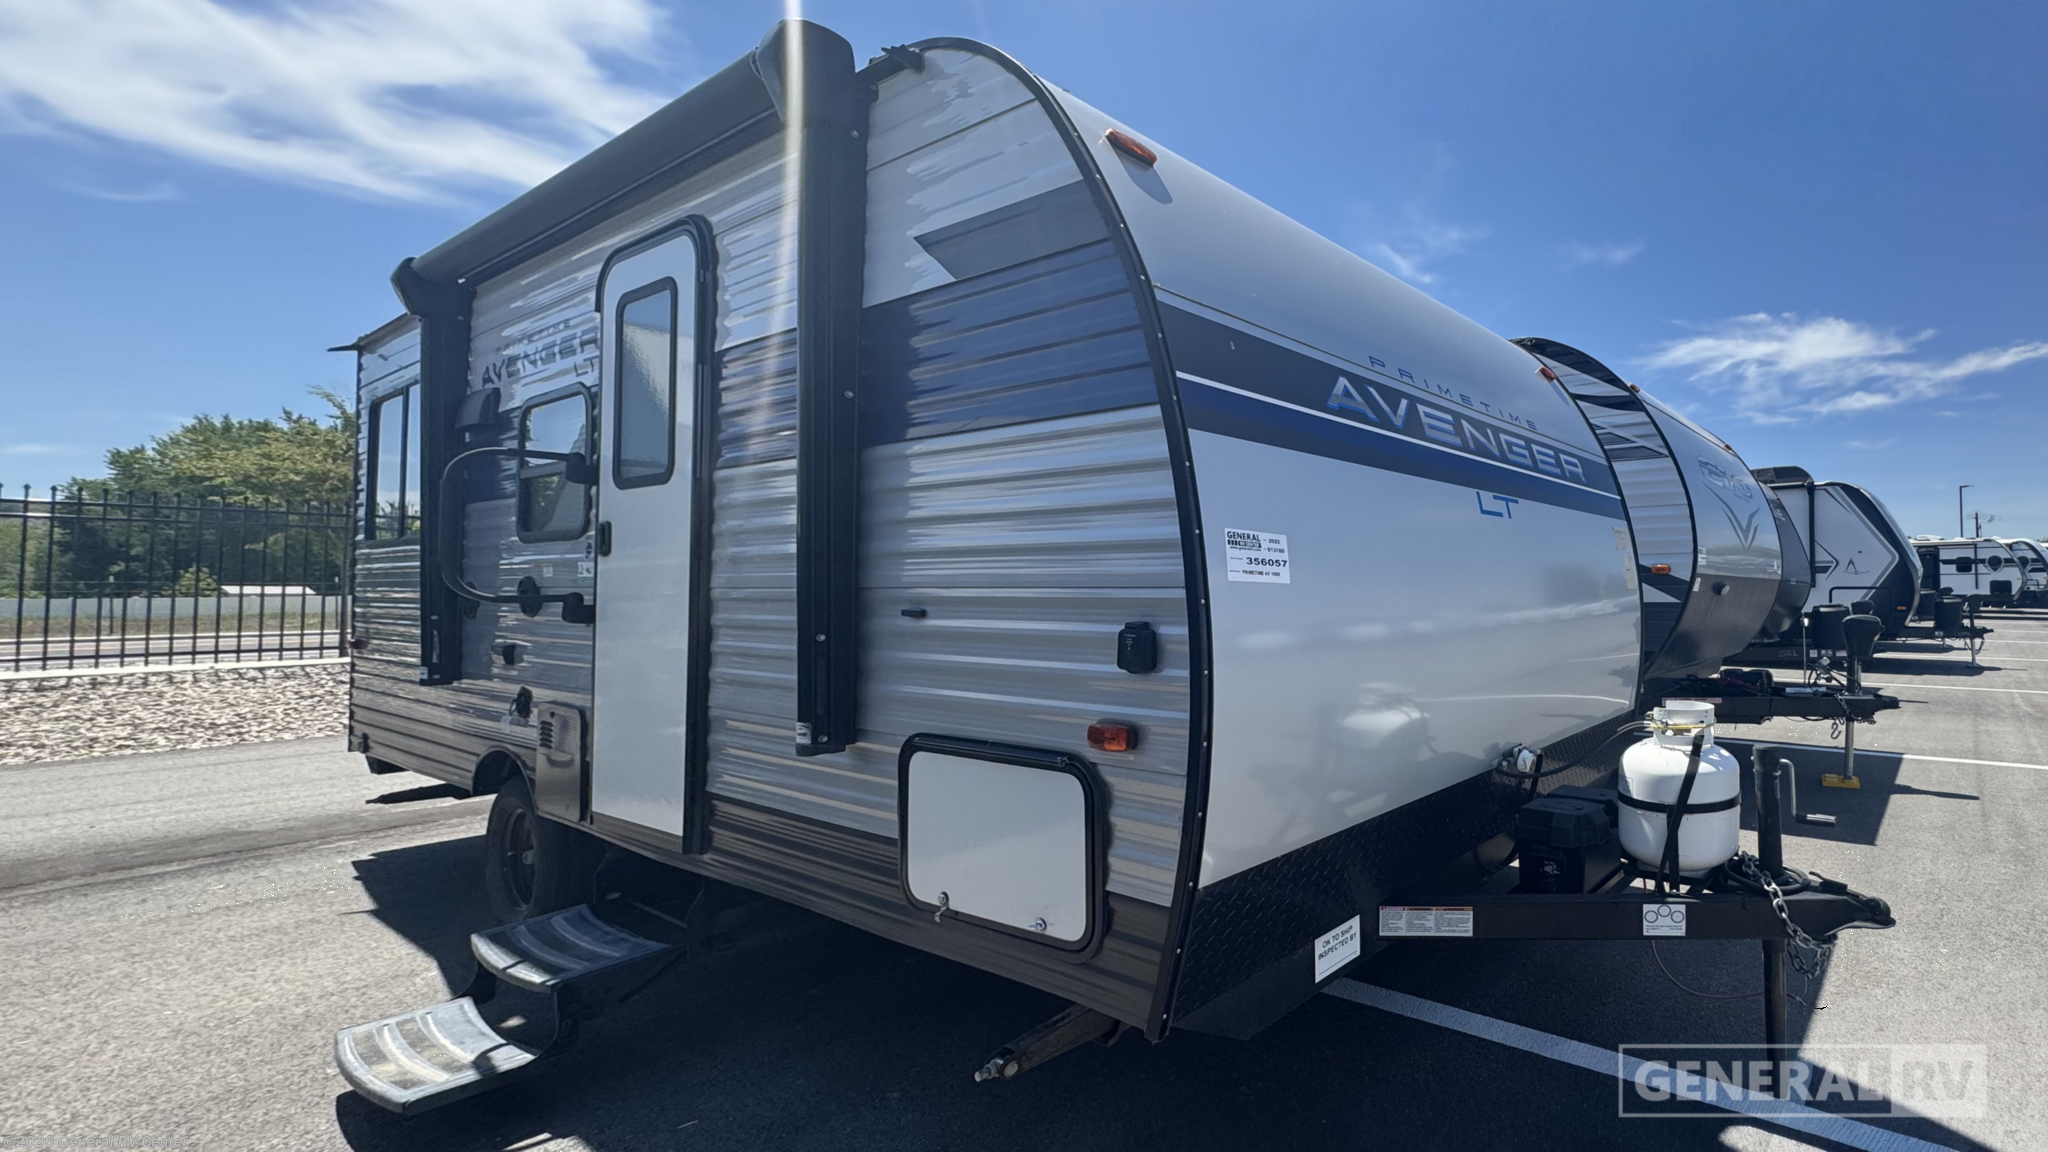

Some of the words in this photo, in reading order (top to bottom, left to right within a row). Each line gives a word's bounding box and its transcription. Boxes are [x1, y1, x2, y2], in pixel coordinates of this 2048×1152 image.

[482, 326, 599, 388] AVENGER
[574, 355, 599, 377] LT
[1368, 355, 1538, 431] PRIMETIME
[1326, 374, 1588, 484] AVENGER
[1475, 490, 1519, 519] LT
[1227, 531, 1260, 541] GENERAL
[1246, 557, 1288, 568] 356057
[1318, 936, 1349, 961] INSPECTED
[1349, 931, 1357, 942] BY
[1322, 938, 1331, 949] OK
[1332, 932, 1340, 943] TO
[1340, 924, 1353, 938] SHIP
